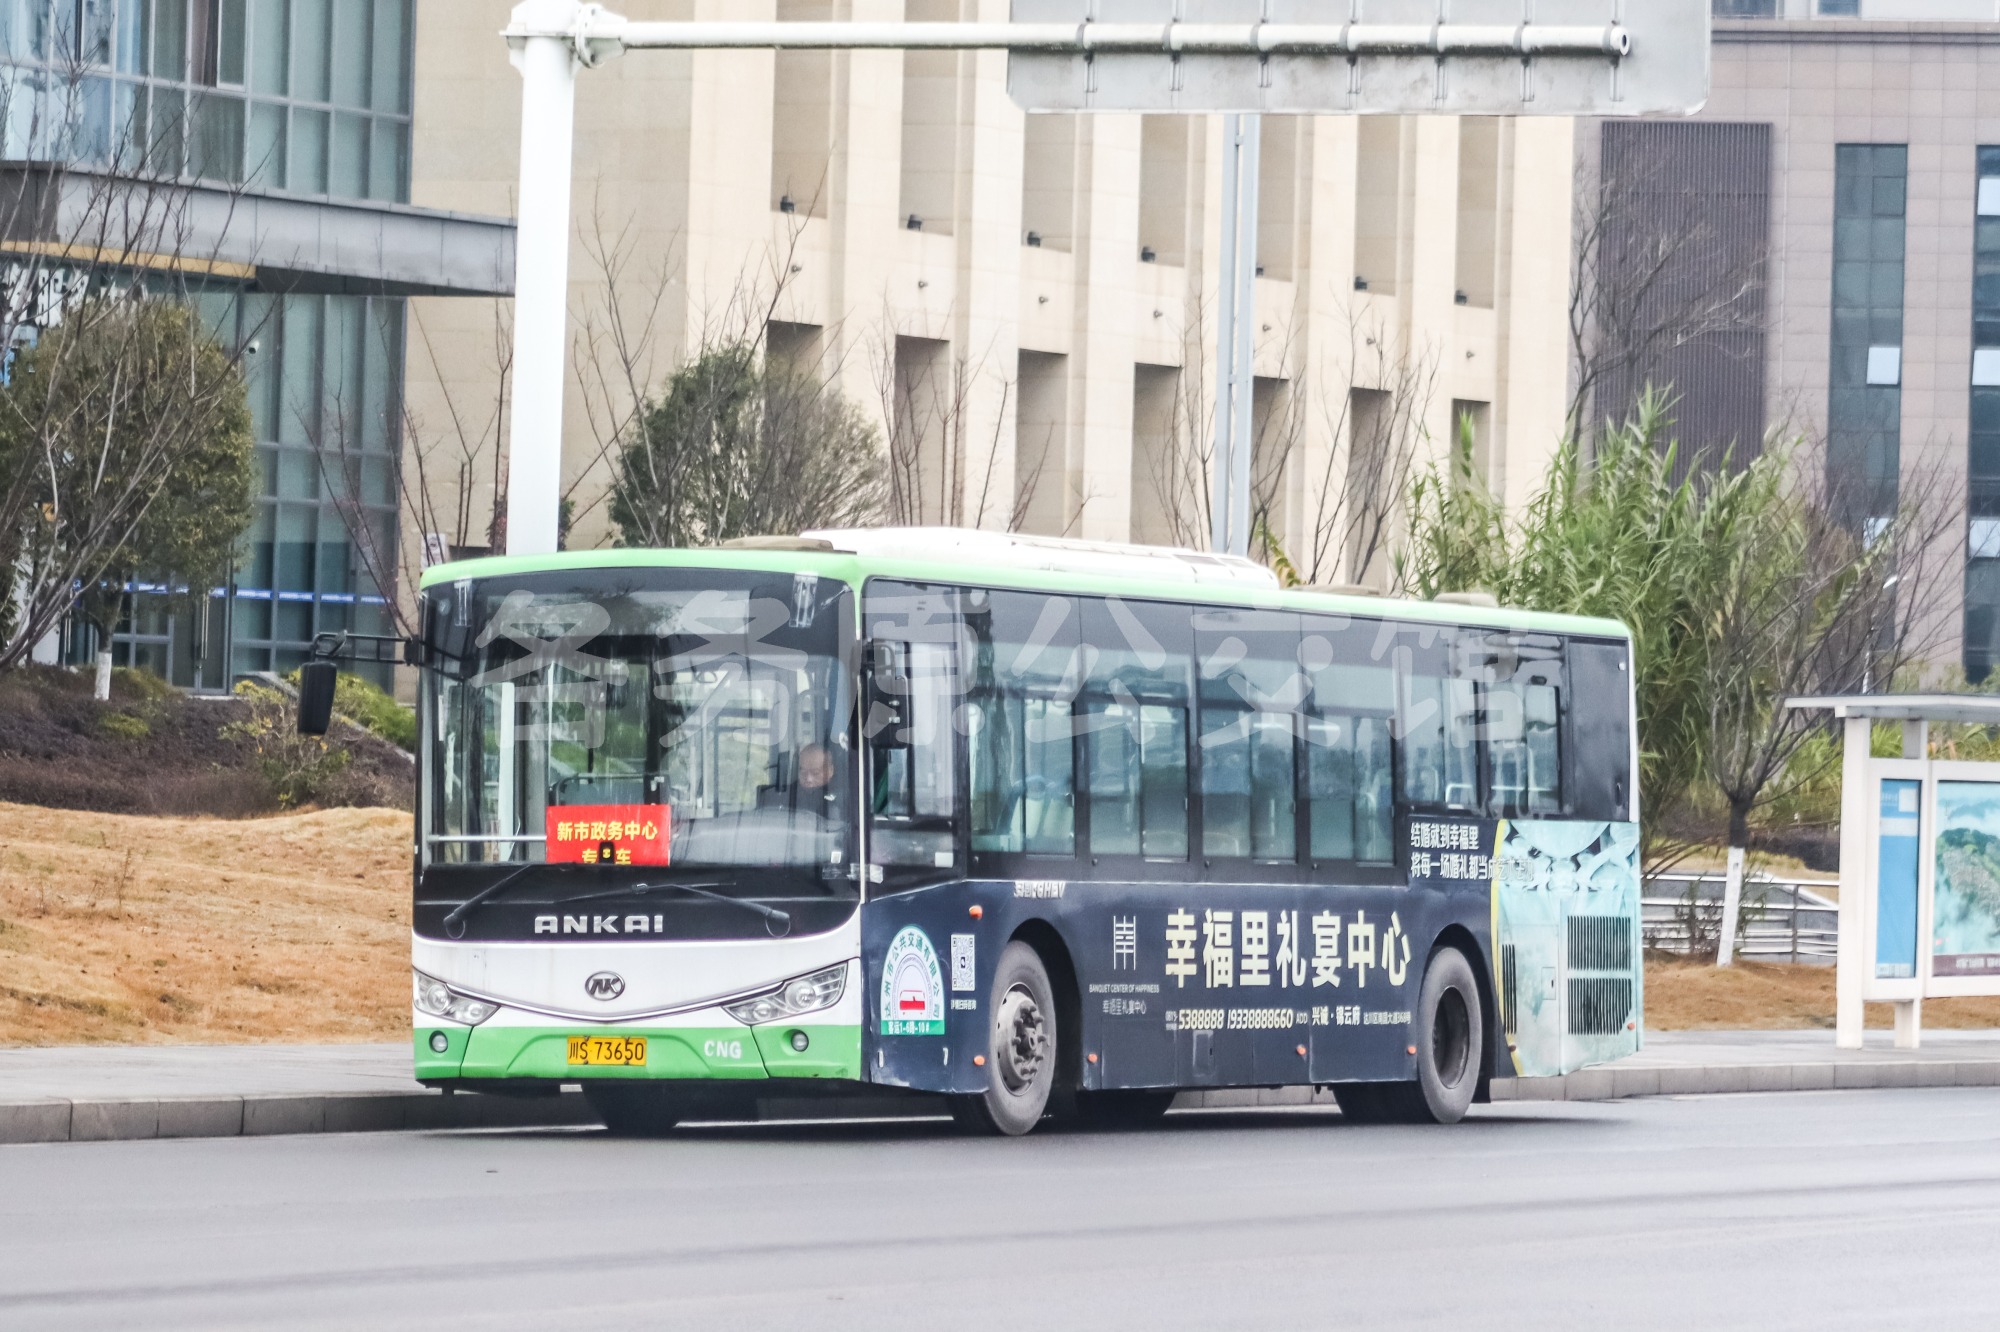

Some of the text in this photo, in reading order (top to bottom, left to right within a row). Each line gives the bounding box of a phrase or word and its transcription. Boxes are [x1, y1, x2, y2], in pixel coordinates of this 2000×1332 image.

[557, 820, 658, 842] 新市政务中心
[1410, 822, 1479, 851] 结婚就到幸福里
[534, 915, 664, 934] ANKAI
[1165, 908, 1411, 989] 幸福里礼宴中心
[1089, 984, 1160, 993] BANQUET CENTER OF HAPPINESS
[1179, 1009, 1224, 1029] 5388888
[1227, 1008, 1294, 1029] 19338888660
[704, 1040, 742, 1059] CNG
